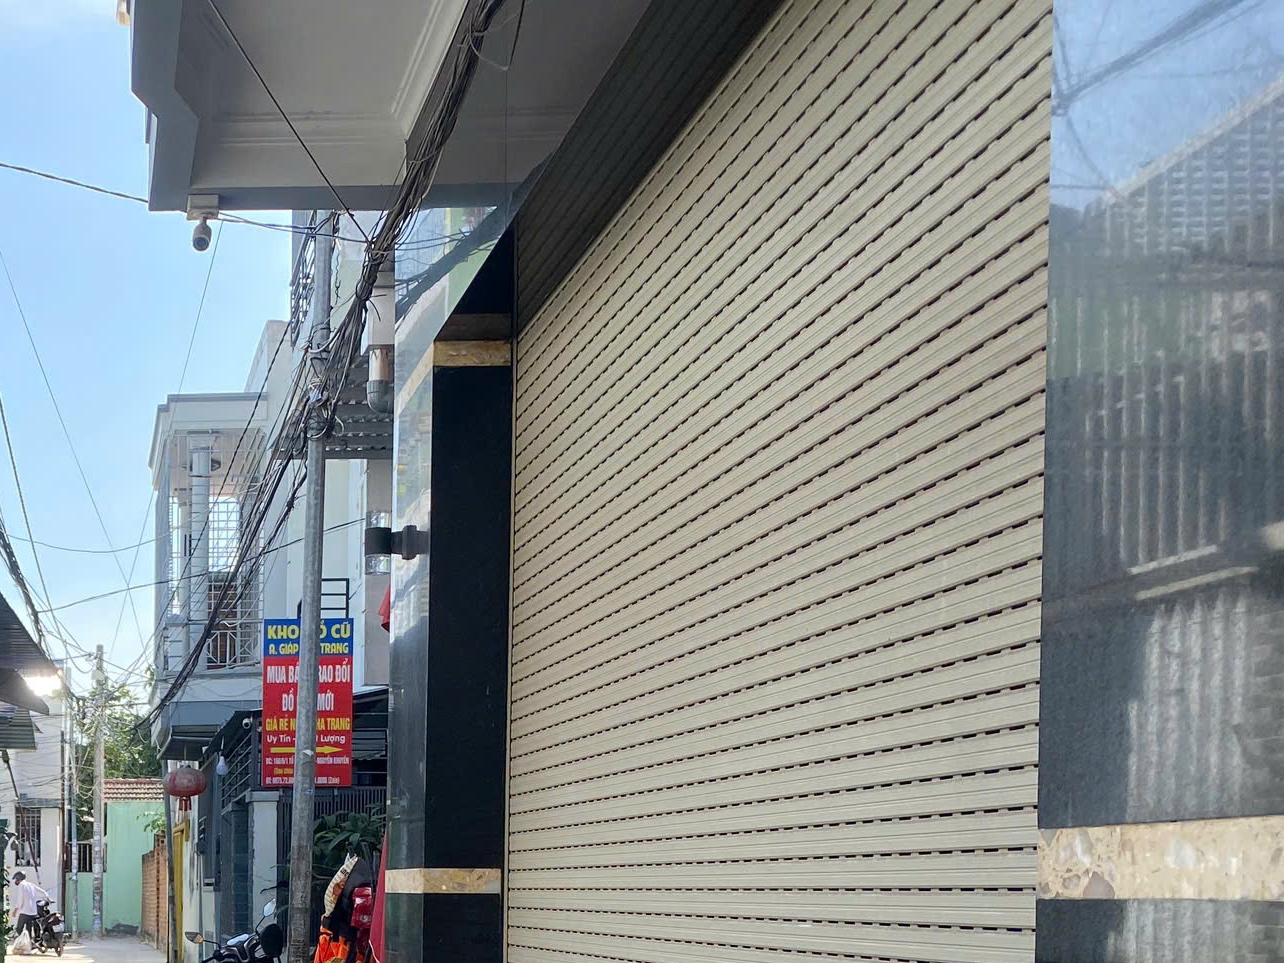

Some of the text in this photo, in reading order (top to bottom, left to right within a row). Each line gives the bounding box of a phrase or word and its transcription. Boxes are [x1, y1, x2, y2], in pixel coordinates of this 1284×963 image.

[267, 624, 299, 639] KHO
[331, 621, 351, 638] CŨ
[320, 643, 349, 654] TRANG
[266, 665, 287, 683] MUA
[335, 658, 350, 683] ĐỔI
[317, 692, 334, 711] MỚI
[265, 716, 278, 731] GIÁ
[328, 717, 351, 731] TRANG
[266, 734, 346, 744] Uy Tín Lượng
